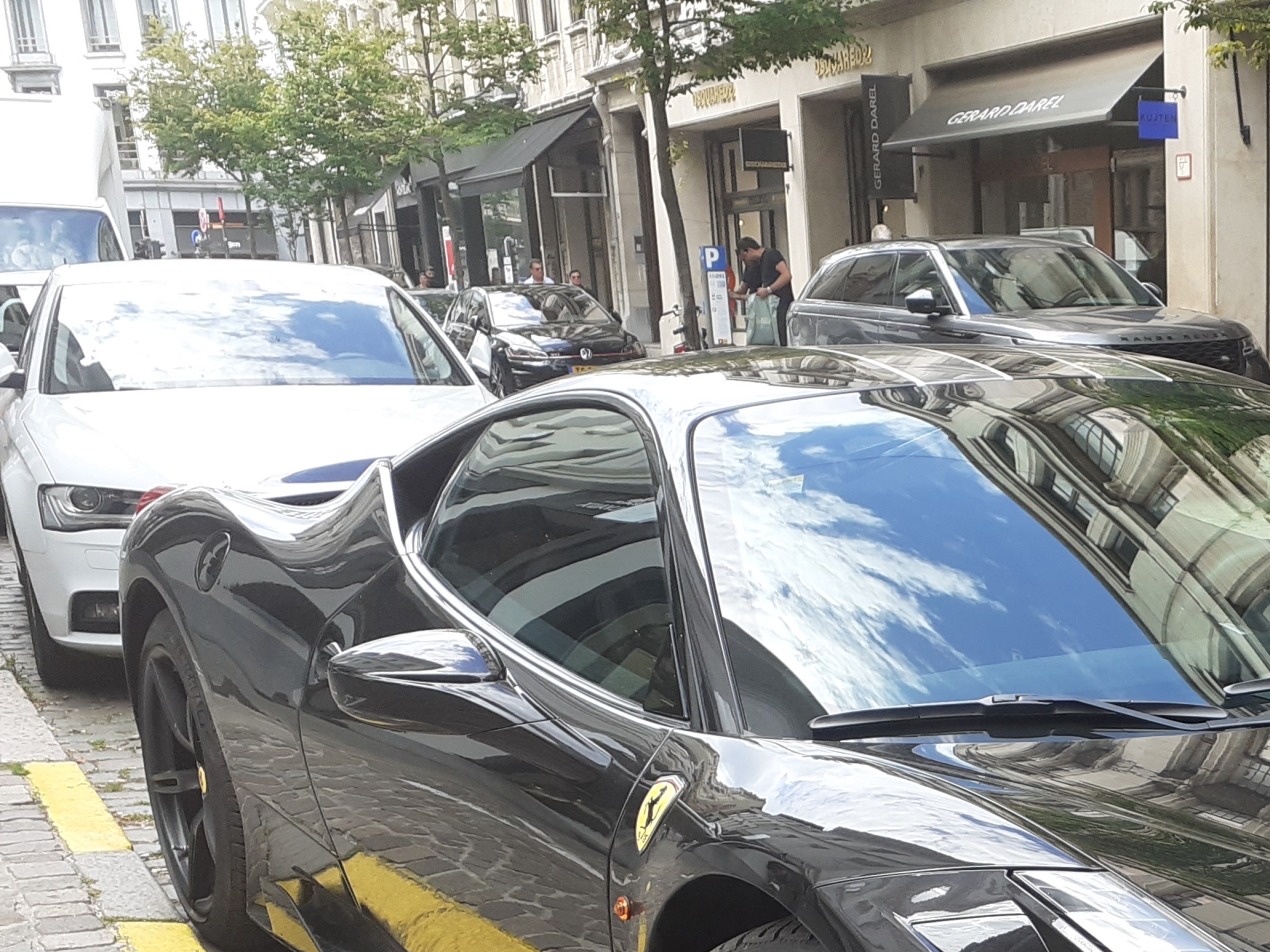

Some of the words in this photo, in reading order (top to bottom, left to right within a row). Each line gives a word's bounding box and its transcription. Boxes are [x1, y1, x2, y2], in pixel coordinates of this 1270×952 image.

[868, 83, 878, 131] DAREL
[947, 105, 1012, 125] GERARD
[1008, 95, 1065, 116] DAREL
[1139, 113, 1177, 123] KUJTEN
[870, 132, 882, 190] GERARD
[704, 247, 720, 269] P
